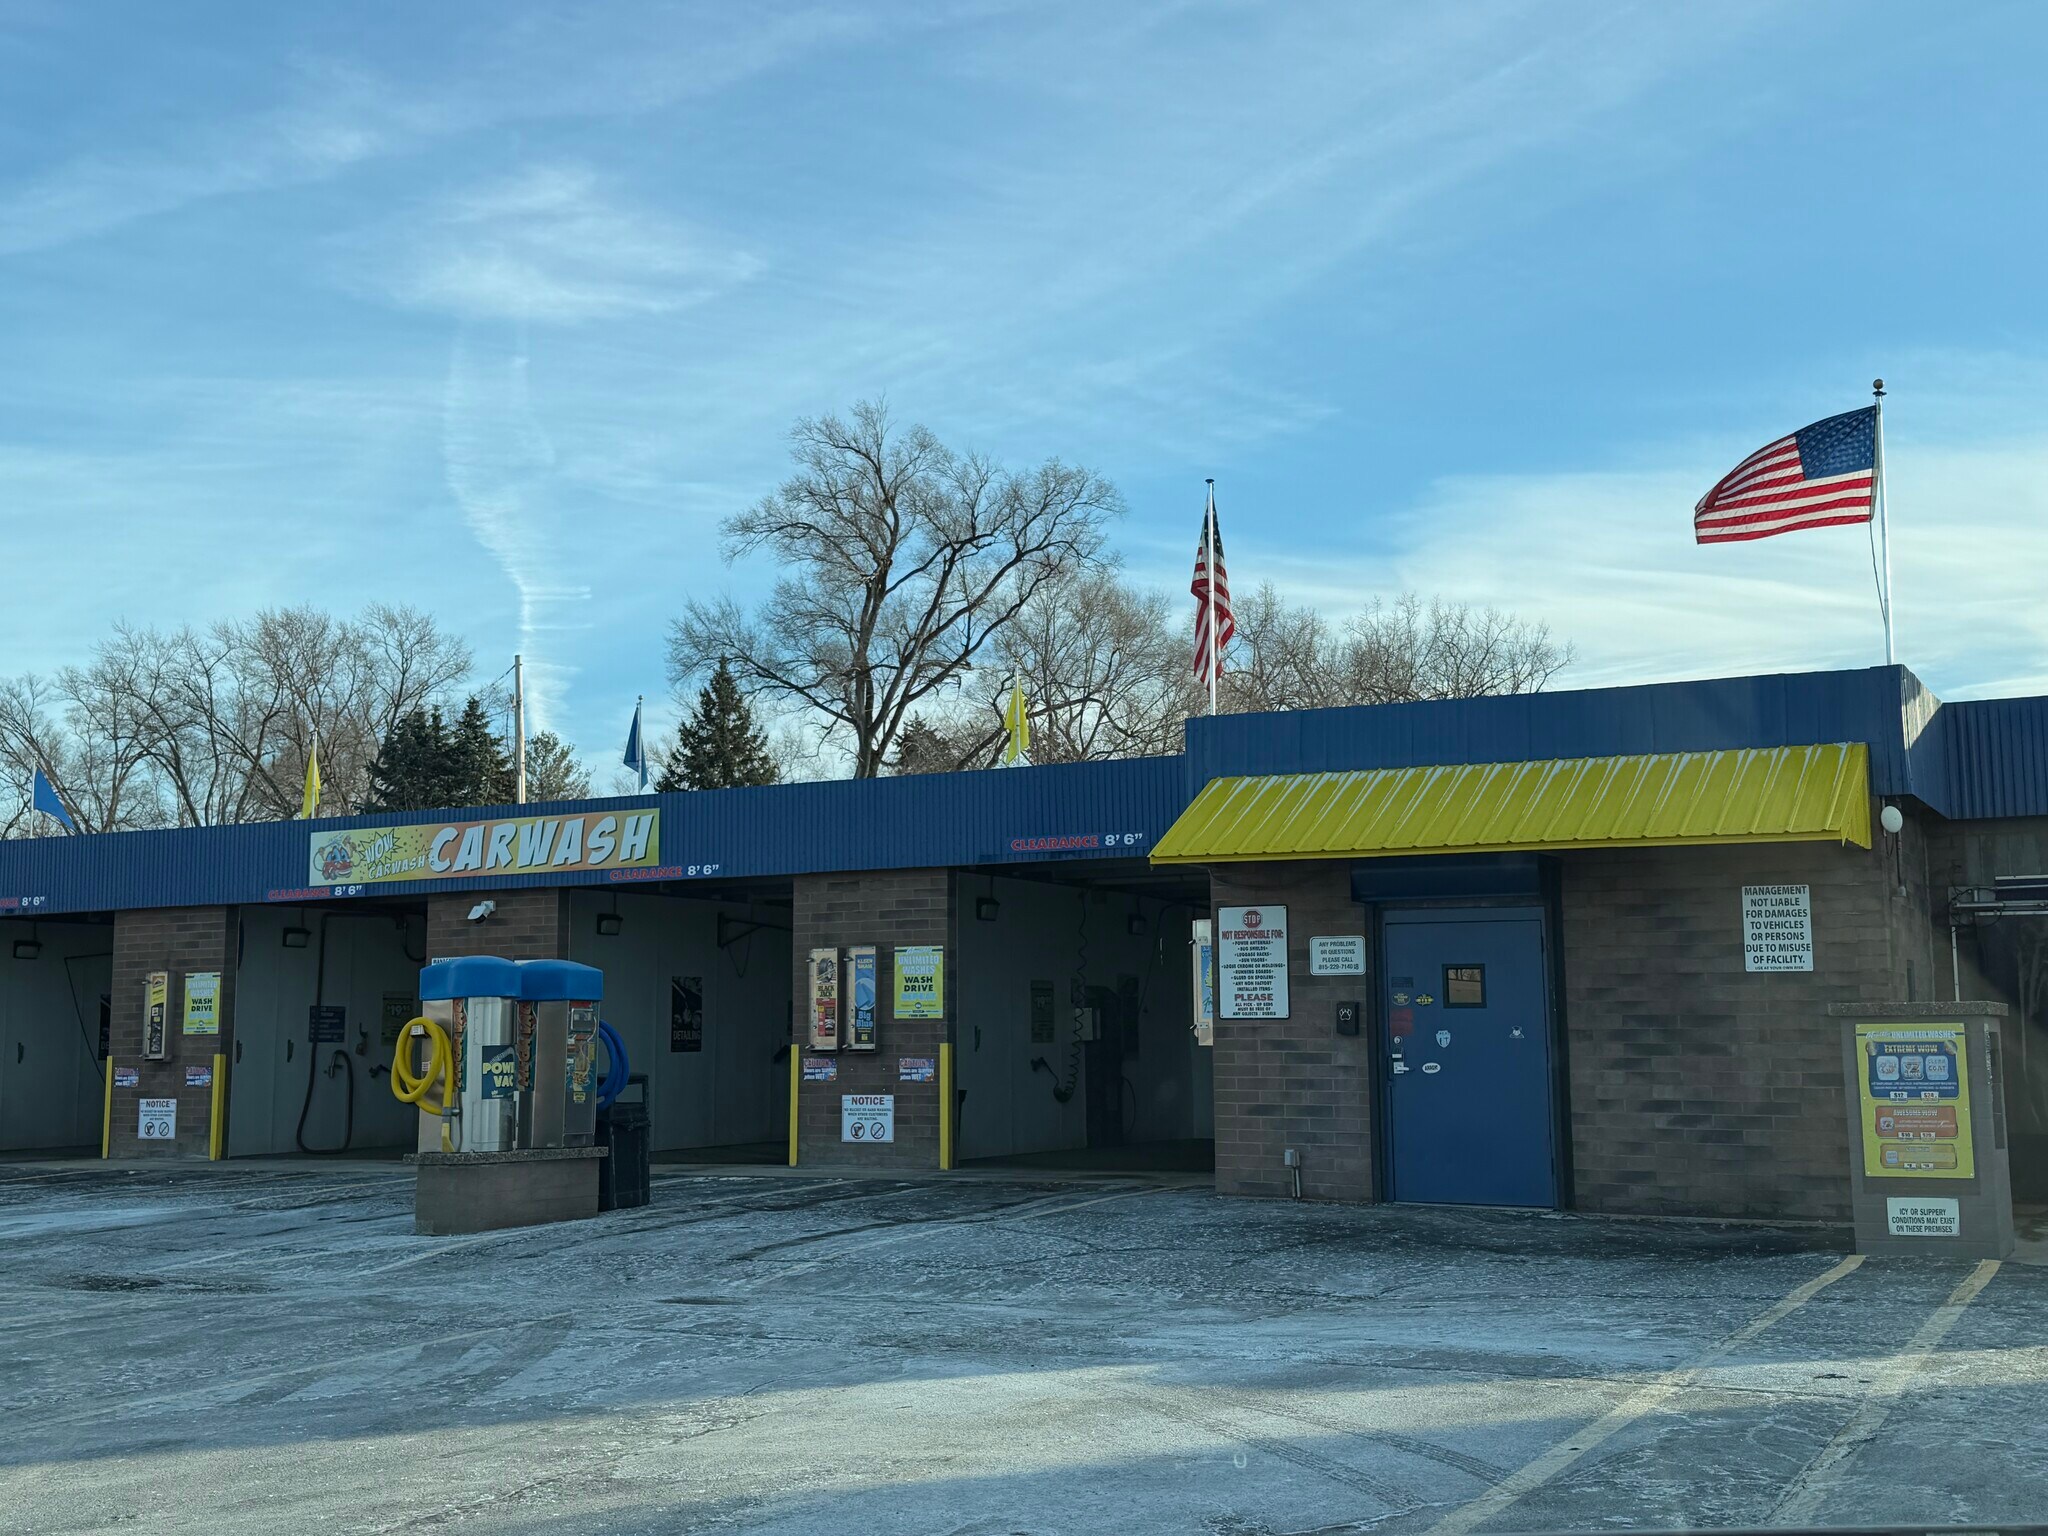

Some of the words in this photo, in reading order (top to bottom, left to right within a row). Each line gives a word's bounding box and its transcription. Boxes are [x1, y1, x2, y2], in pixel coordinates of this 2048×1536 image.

[430, 814, 654, 873] CARWASH
[1011, 835, 1099, 851] CLEARANCE
[368, 855, 426, 880] CARWASH
[609, 866, 683, 881] CLEARANCE
[268, 887, 331, 901] CLEARANCE
[1744, 885, 1807, 896] MANAGEMENT
[1750, 898, 1768, 907] NOT
[1770, 897, 1801, 907] LIABLE
[1745, 910, 1763, 919] FOR
[1764, 908, 1808, 918] DAMAGES
[1243, 915, 1261, 925] STOP
[1750, 921, 1762, 930] TO
[1763, 920, 1805, 930] VEHICLES
[1221, 931, 1233, 941] NOT
[1233, 930, 1271, 940] RESPONSIBLE
[1751, 932, 1763, 941] OR
[1765, 932, 1805, 941] PERSONS
[1745, 944, 1764, 953] DUE
[1765, 943, 1777, 953] TO
[1778, 943, 1811, 952] MISUSE
[898, 955, 939, 965] UNLIMITED
[1753, 955, 1765, 964] OF
[1766, 955, 1806, 964] FACILITY.
[902, 965, 936, 975] WASHES
[904, 976, 933, 984] WASH
[904, 984, 934, 992] DRIVE
[1234, 993, 1274, 1002] PLEASE
[858, 1011, 872, 1020] Big
[856, 1019, 874, 1028] Blue
[1891, 1031, 1931, 1039] UNLIMITED
[1930, 1030, 1956, 1039] WASHES
[1884, 1044, 1917, 1054] EXTREME
[145, 1100, 171, 1108] NOTICE
[851, 1096, 885, 1106] NOTICE
[1899, 1208, 1909, 1216] ICY
[1910, 1208, 1919, 1216] OR
[1919, 1208, 1947, 1216] SLIPPERY
[1891, 1216, 1926, 1225] CONDITIONS
[1926, 1217, 1938, 1225] MAY
[1939, 1217, 1956, 1225] EXIST
[1896, 1225, 1905, 1233] ON
[1906, 1225, 1923, 1233] THESE
[1924, 1225, 1953, 1233] PREMISES
